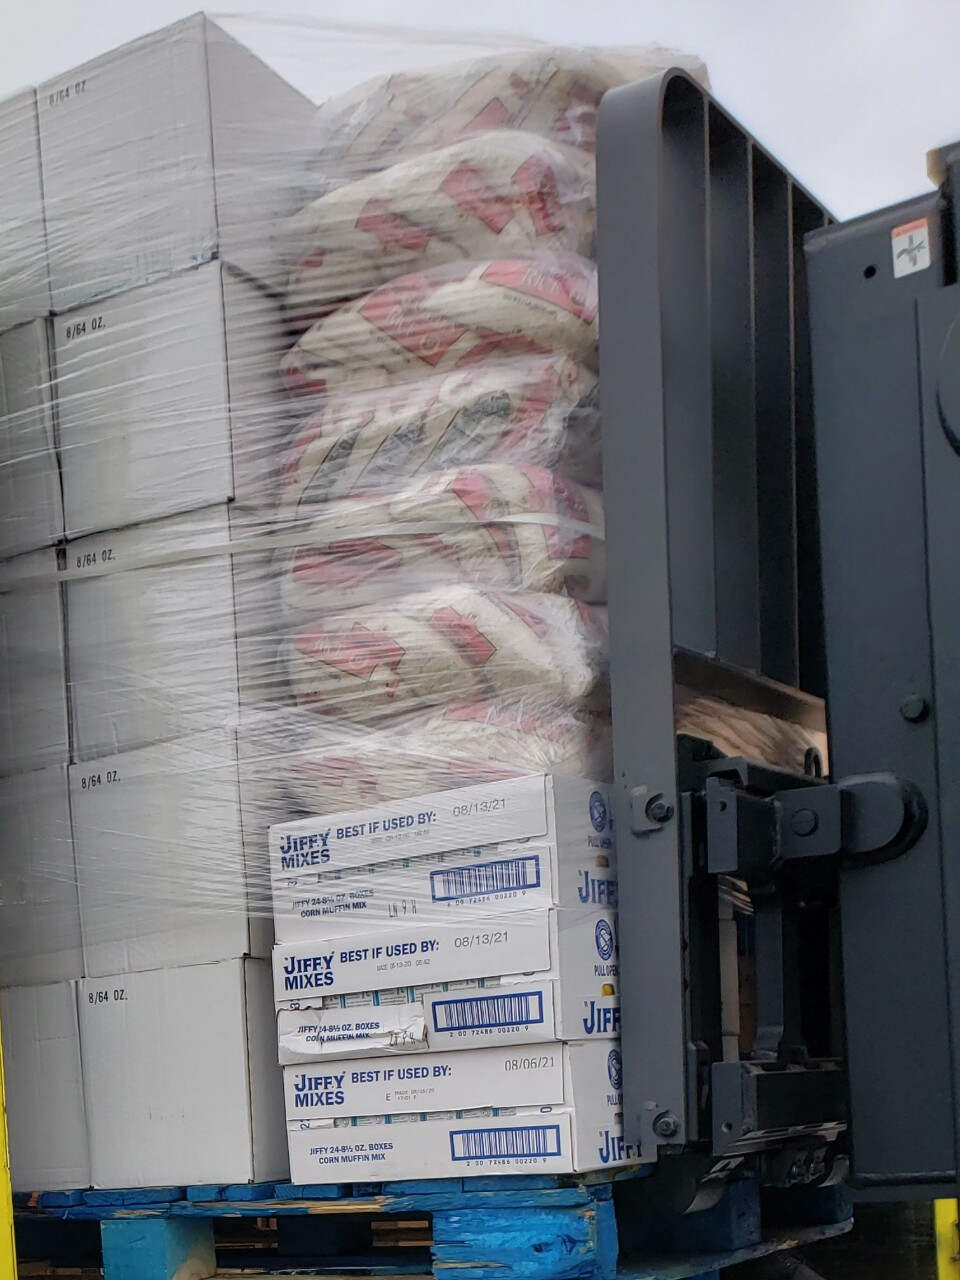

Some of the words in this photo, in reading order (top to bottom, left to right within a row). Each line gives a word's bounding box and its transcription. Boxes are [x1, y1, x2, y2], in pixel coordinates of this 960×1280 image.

[81, 773, 102, 790] 8/64
[336, 824, 366, 840] BEST
[369, 820, 381, 834] IF
[382, 815, 414, 832] USED
[418, 811, 437, 825] BY:
[453, 798, 506, 817] 08/13/21
[280, 848, 331, 872] MIXES
[577, 869, 619, 904] JIFF
[300, 908, 320, 918] CORN
[352, 901, 367, 909] MIX
[340, 950, 369, 964] BEST
[372, 946, 383, 960] IF
[386, 942, 418, 957] USED
[421, 939, 440, 953] BY:
[454, 931, 509, 948] 08/13/21
[284, 971, 334, 991] MIXES
[88, 991, 109, 1005] 8/64
[113, 989, 128, 1001] OZ.
[355, 1021, 381, 1031] BOXES
[582, 1000, 621, 1035] JIFF
[351, 1071, 381, 1084] BEST
[384, 1069, 395, 1081] IF
[398, 1066, 429, 1080] USED
[433, 1065, 452, 1077] BY:
[504, 1056, 555, 1071] 08/06/21
[295, 1091, 345, 1108] MIXES
[310, 1147, 329, 1155] JIFFY
[355, 1143, 368, 1152] OZ.
[369, 1142, 394, 1151] BOXES
[319, 1156, 340, 1165] CORN
[341, 1154, 370, 1164] MUFFIN
[371, 1152, 386, 1161] MIX
